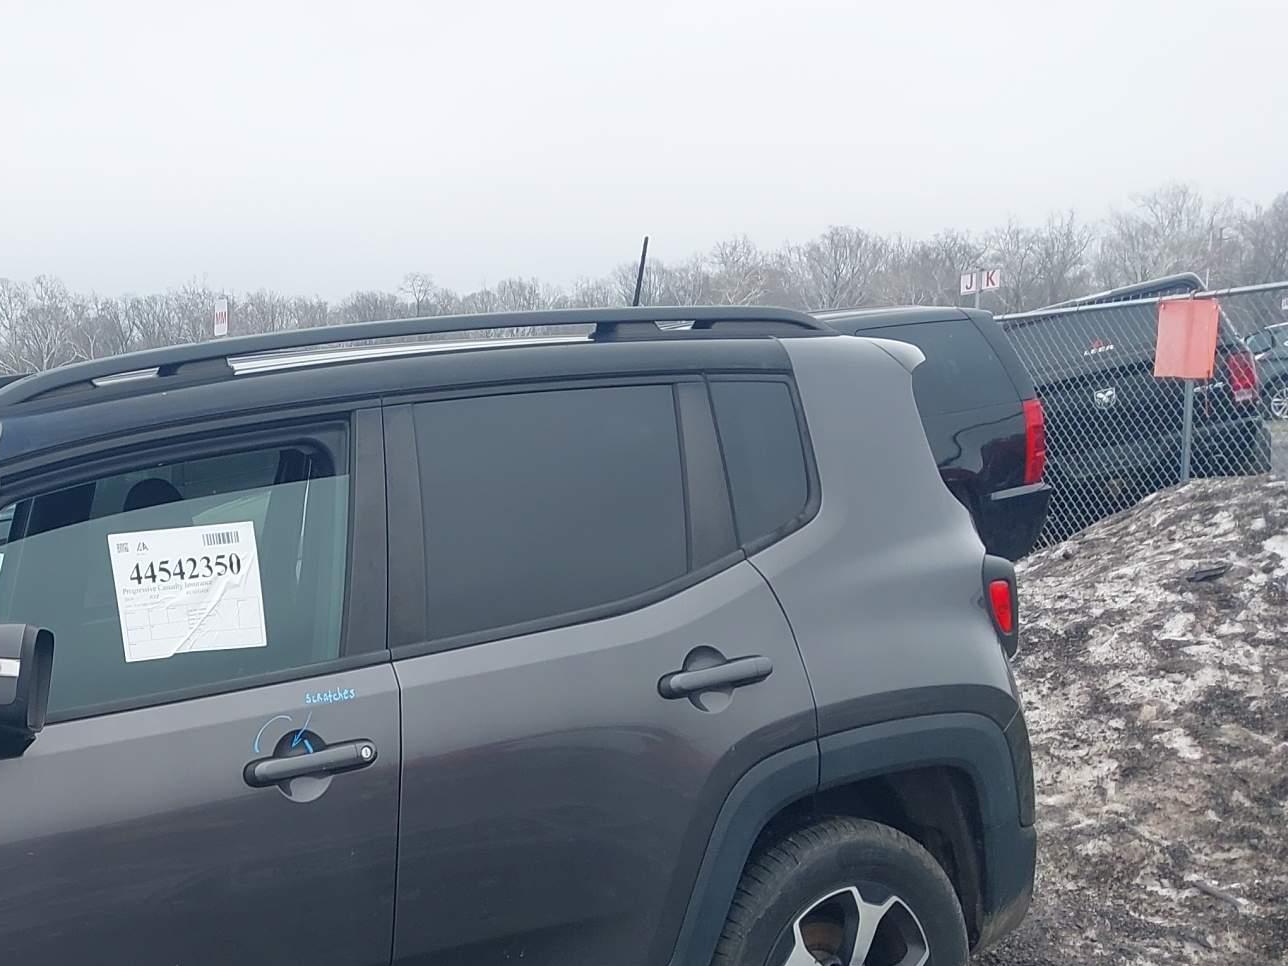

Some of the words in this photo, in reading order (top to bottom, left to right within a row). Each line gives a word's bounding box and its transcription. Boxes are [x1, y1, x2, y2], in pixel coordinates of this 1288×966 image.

[965, 272, 973, 290] J
[986, 270, 996, 287] K
[130, 552, 241, 585] 44542350
